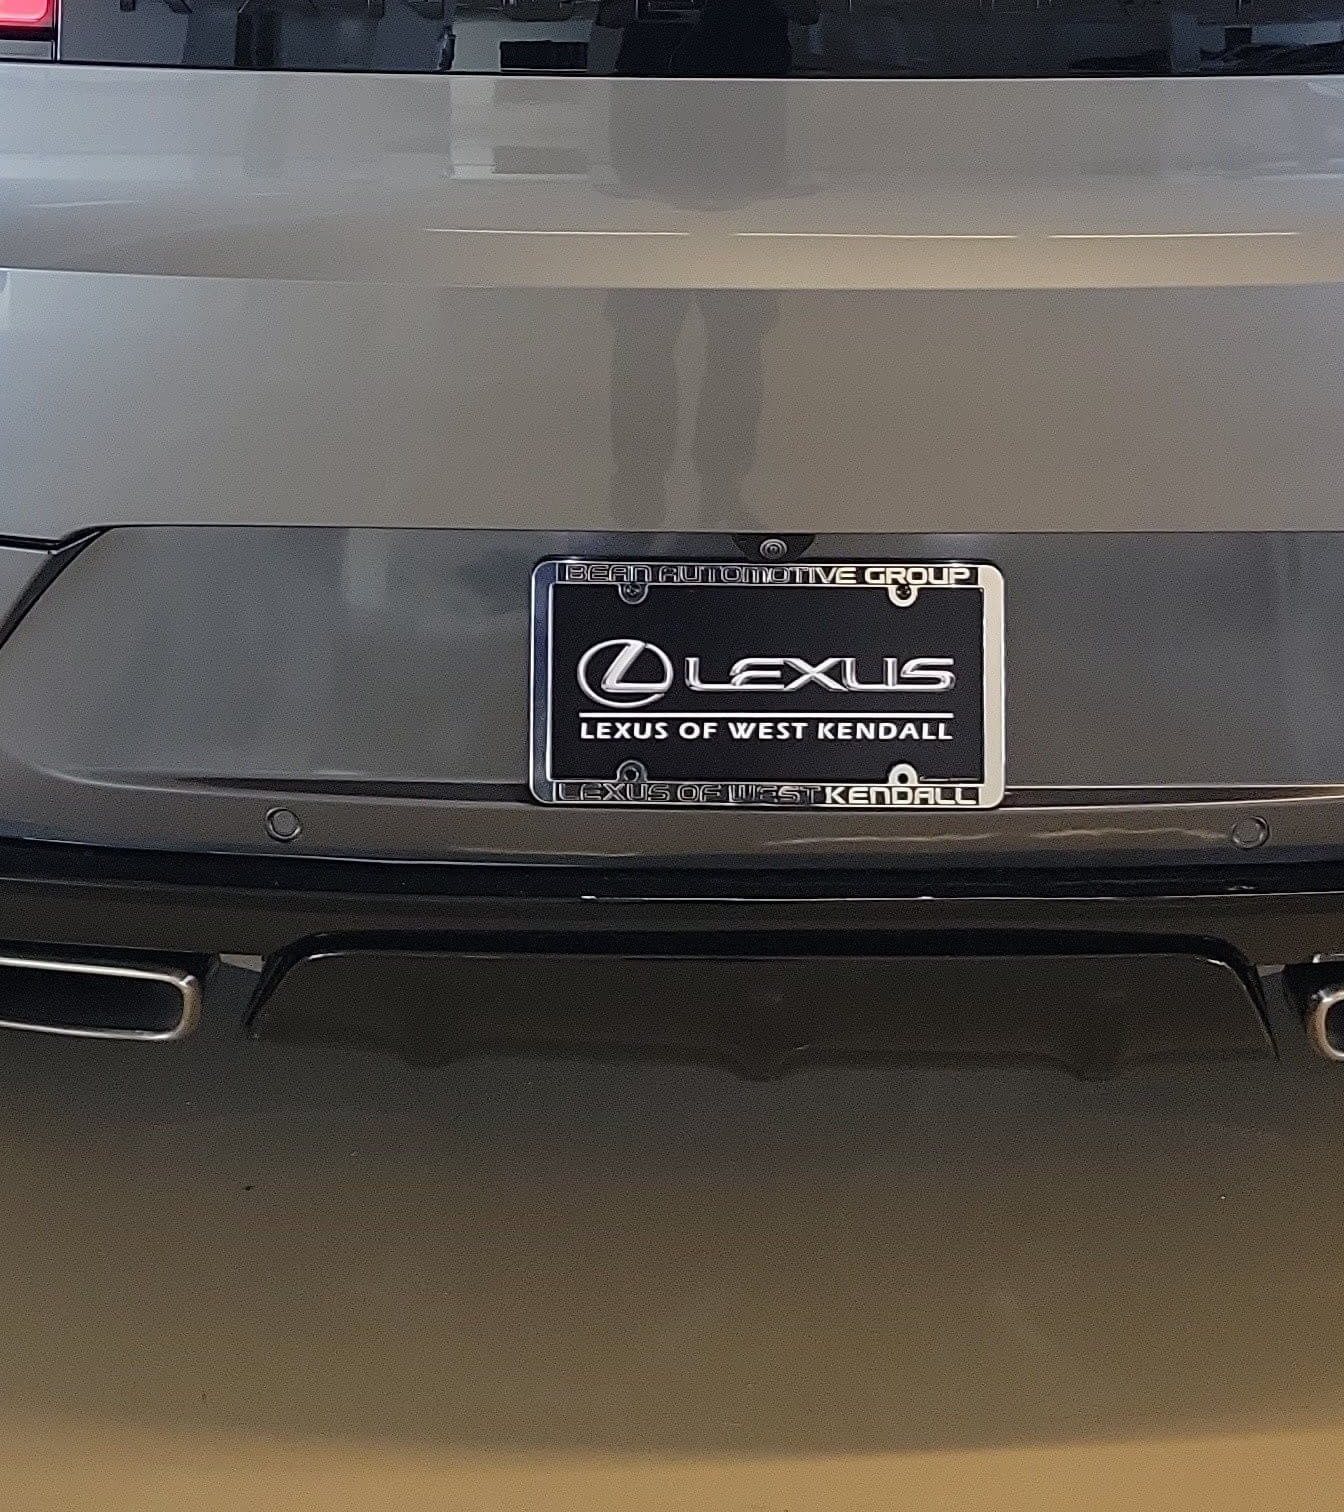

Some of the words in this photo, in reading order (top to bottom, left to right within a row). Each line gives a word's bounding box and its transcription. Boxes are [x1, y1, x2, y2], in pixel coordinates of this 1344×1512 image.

[565, 564, 652, 583] BEAN
[659, 565, 857, 585] AUTOMOTIVE
[864, 568, 971, 585] GROUP
[685, 657, 955, 692] LEXUS
[580, 722, 669, 740] LEXUS
[679, 722, 718, 740] OF
[728, 722, 809, 740] WEST
[817, 722, 953, 741] KENDALL
[559, 782, 670, 802] LEXUS
[677, 784, 721, 802] OF
[728, 784, 820, 804] WEST
[825, 786, 977, 805] KENDALL
